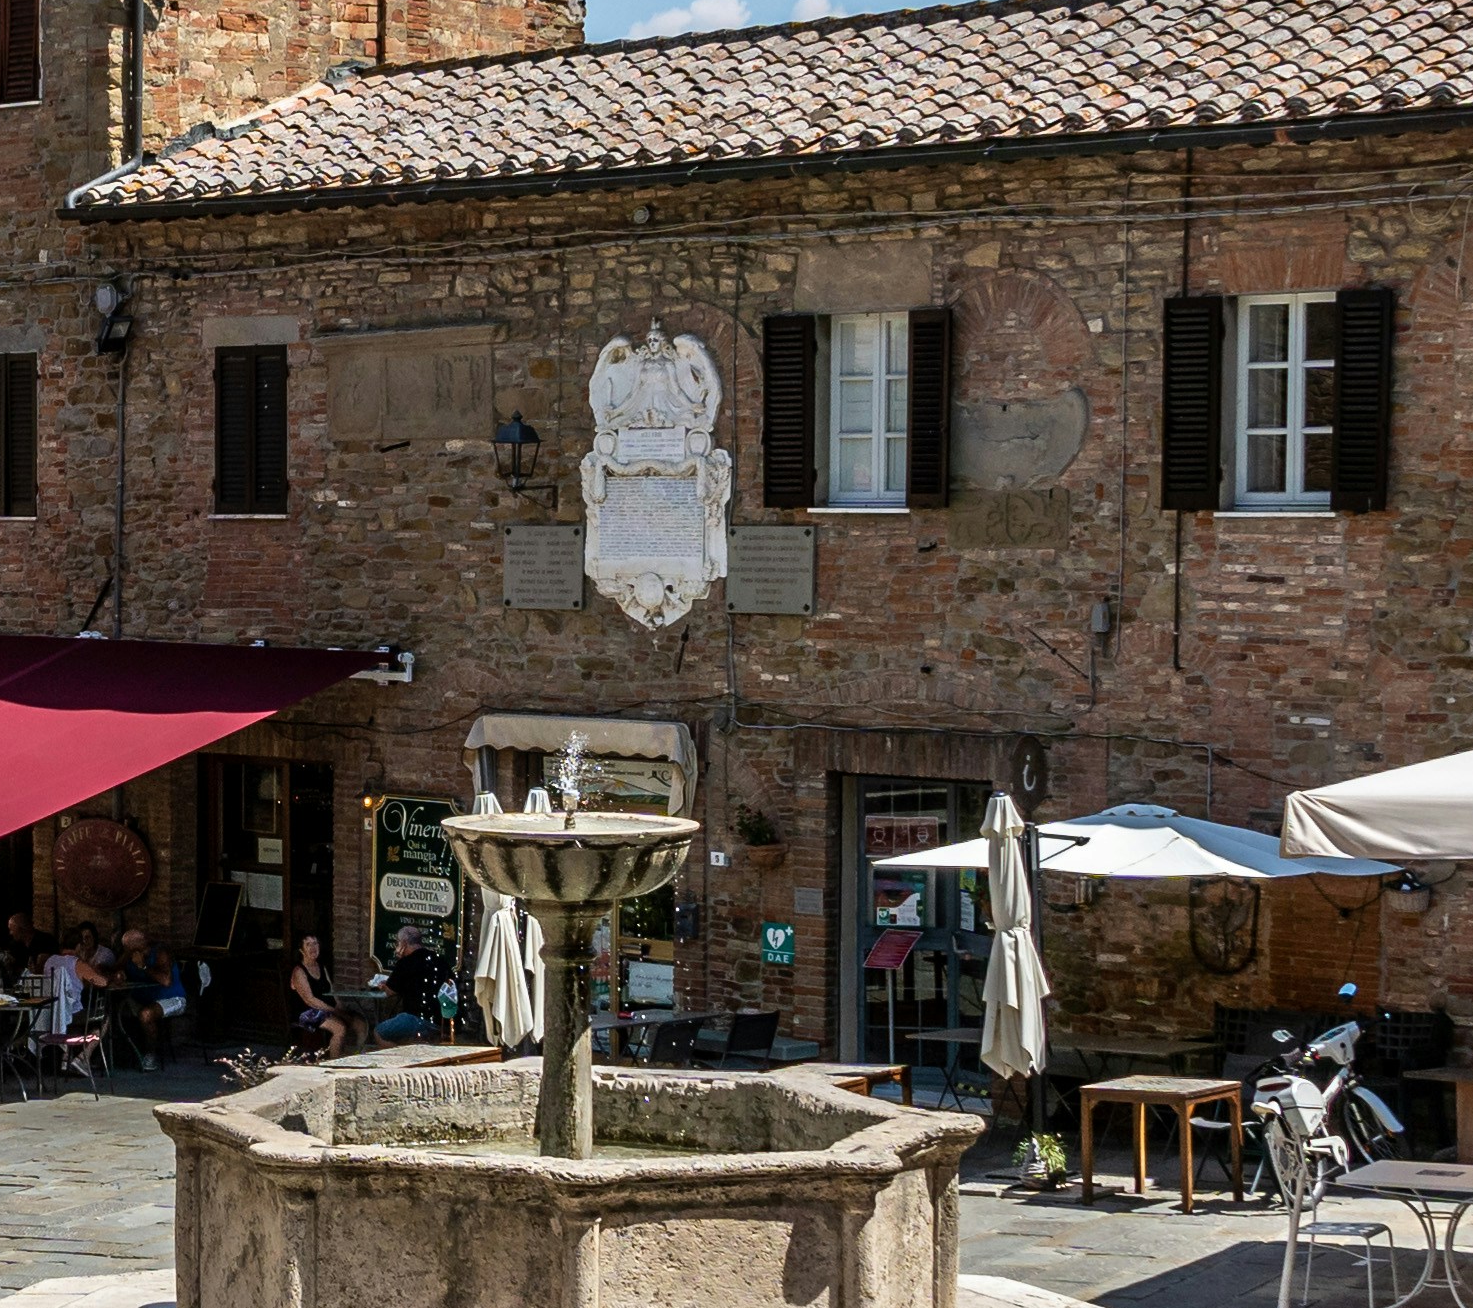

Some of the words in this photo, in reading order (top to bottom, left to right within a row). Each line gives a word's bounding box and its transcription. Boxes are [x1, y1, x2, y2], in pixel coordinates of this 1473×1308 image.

[407, 840, 421, 851] Qui
[403, 849, 437, 863] mangia
[429, 862, 451, 875] beve
[386, 876, 450, 892] DEGUSTAZIONE
[402, 889, 439, 902] VENDITA
[394, 902, 427, 912] PRODOTTI
[428, 904, 448, 914] TIPICI
[767, 953, 790, 964] DAE
